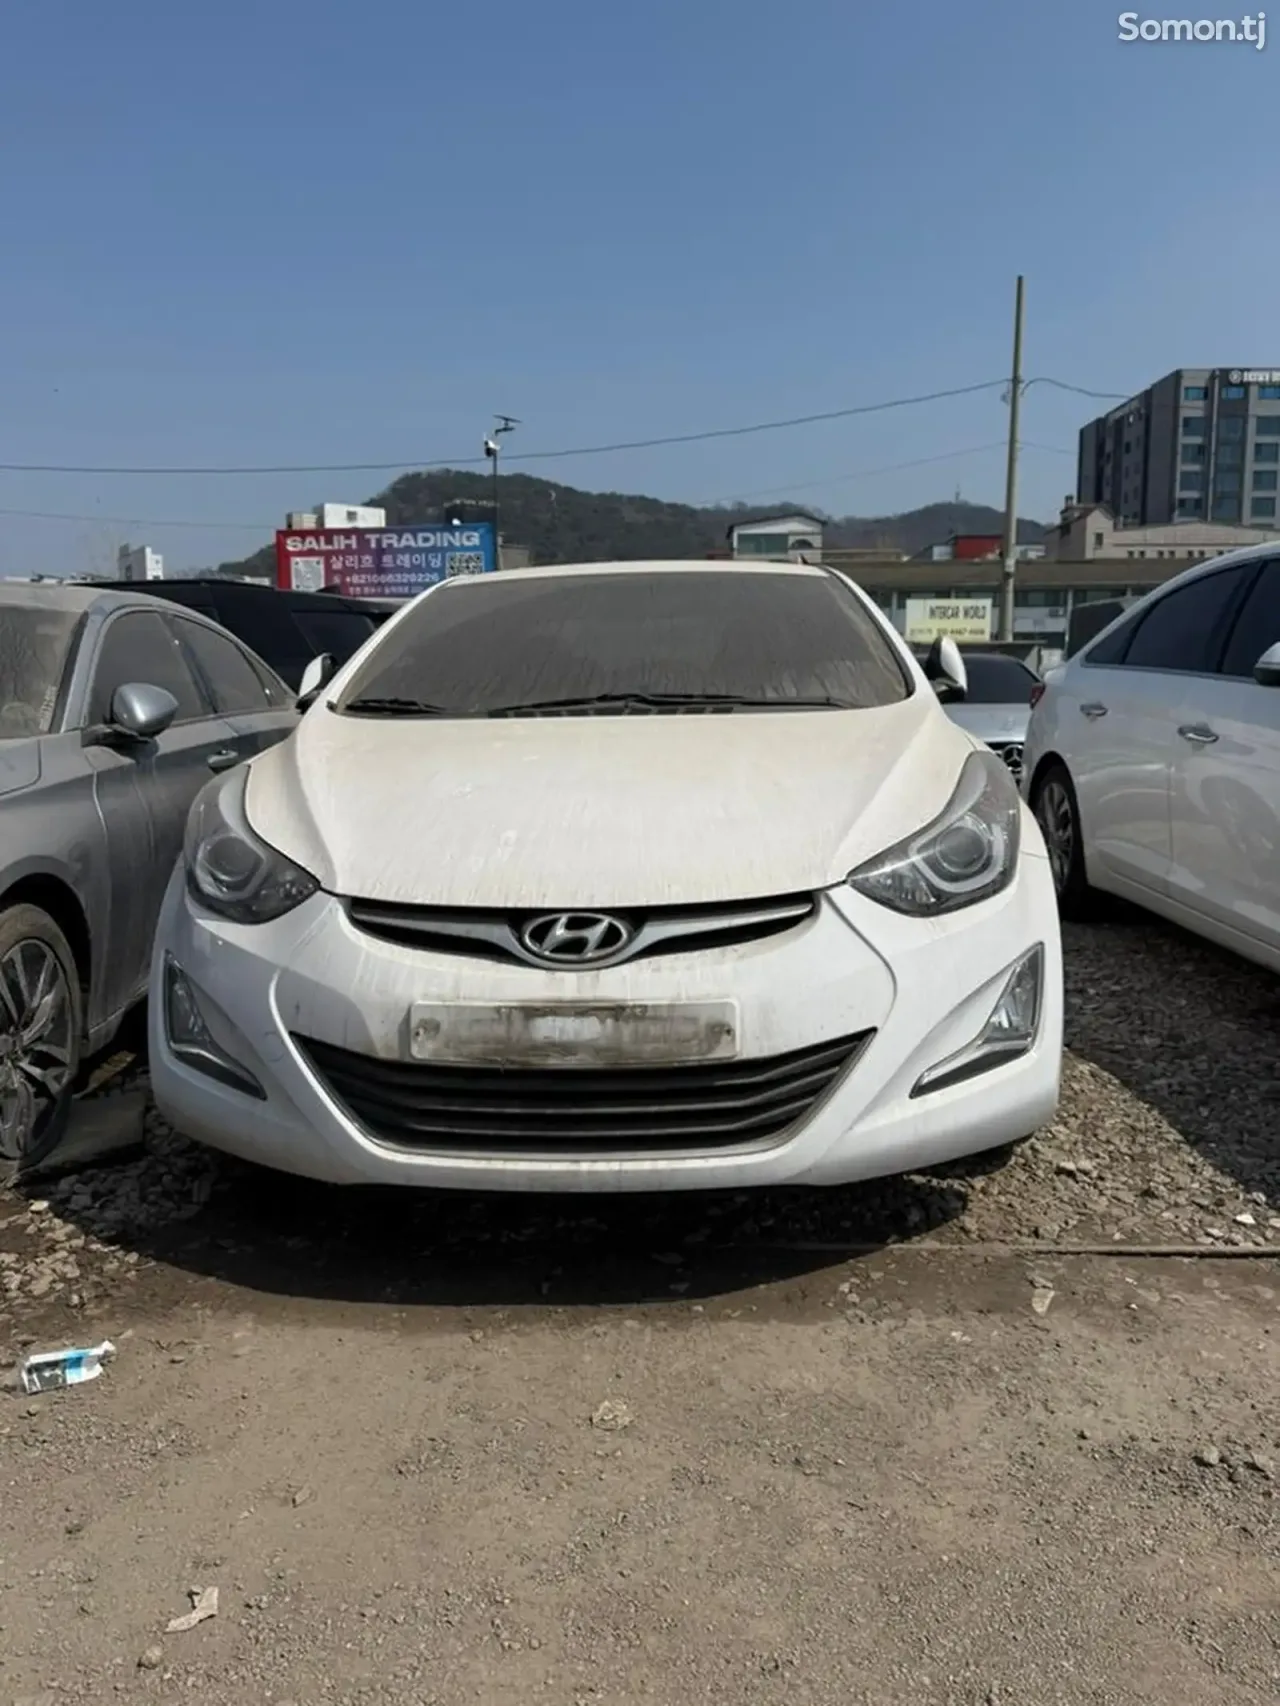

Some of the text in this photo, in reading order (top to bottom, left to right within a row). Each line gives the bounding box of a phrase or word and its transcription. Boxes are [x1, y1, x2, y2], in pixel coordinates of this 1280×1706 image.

[286, 531, 481, 551] SALIH TRADING
[381, 552, 442, 569] 트레이딩
